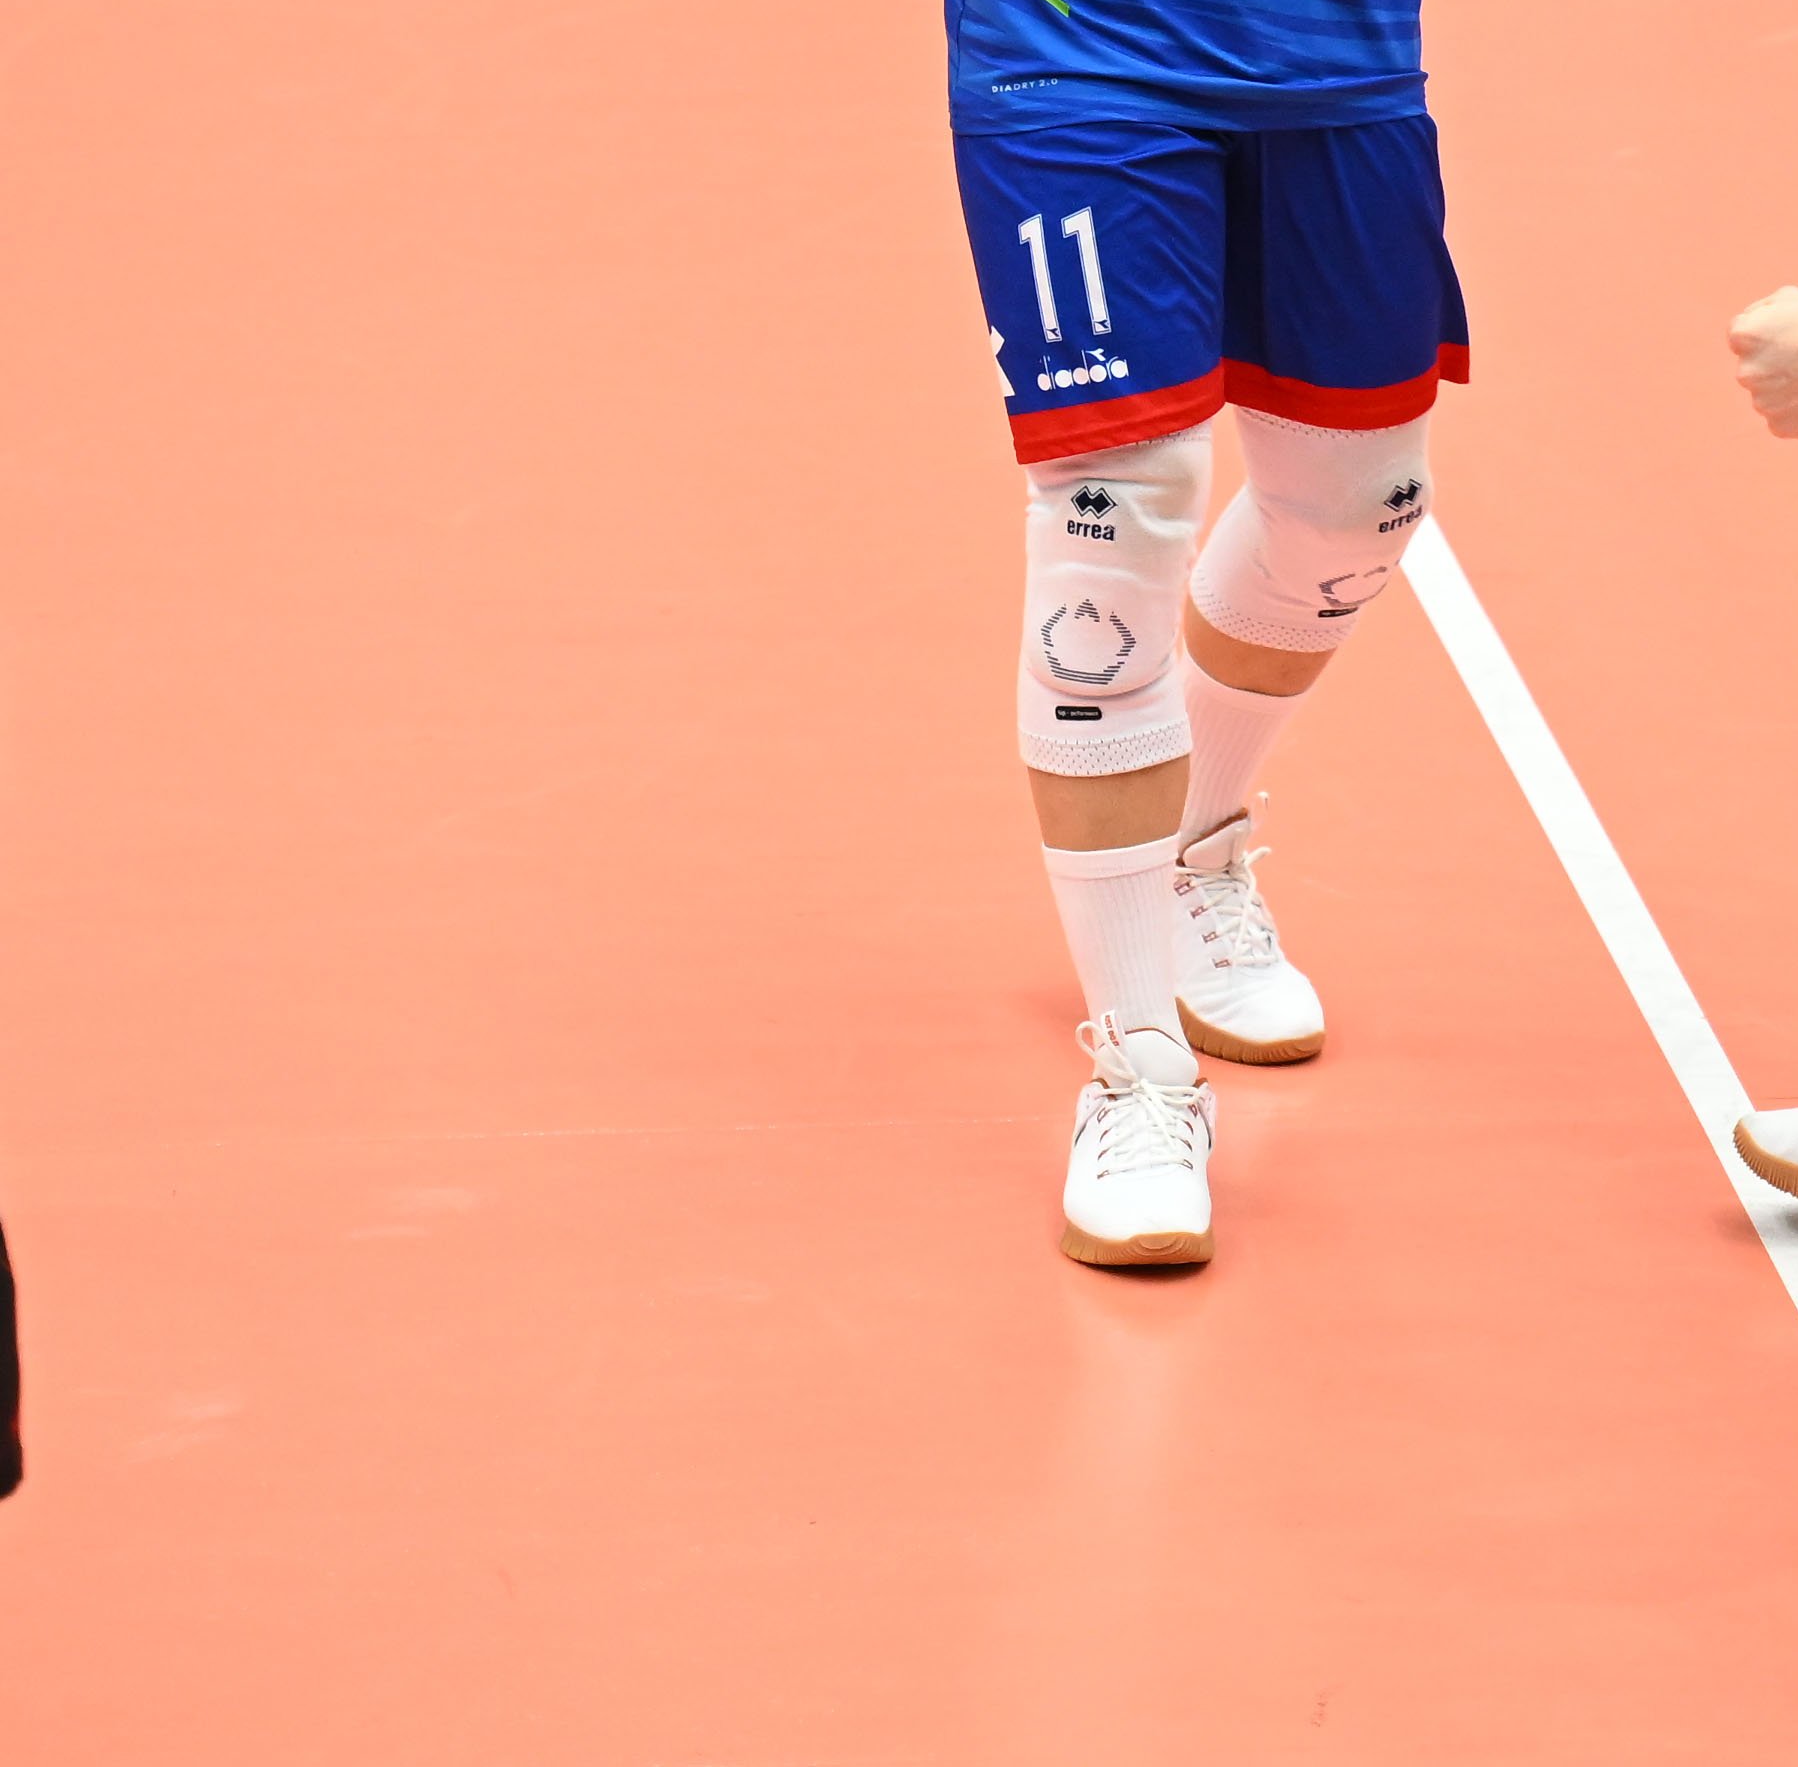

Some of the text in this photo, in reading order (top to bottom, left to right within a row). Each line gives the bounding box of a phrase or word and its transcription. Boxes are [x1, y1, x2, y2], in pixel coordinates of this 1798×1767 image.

[991, 78, 1058, 93] DIADRY 2.0
[1017, 206, 1113, 343] 11
[1036, 348, 1129, 392] diadora
